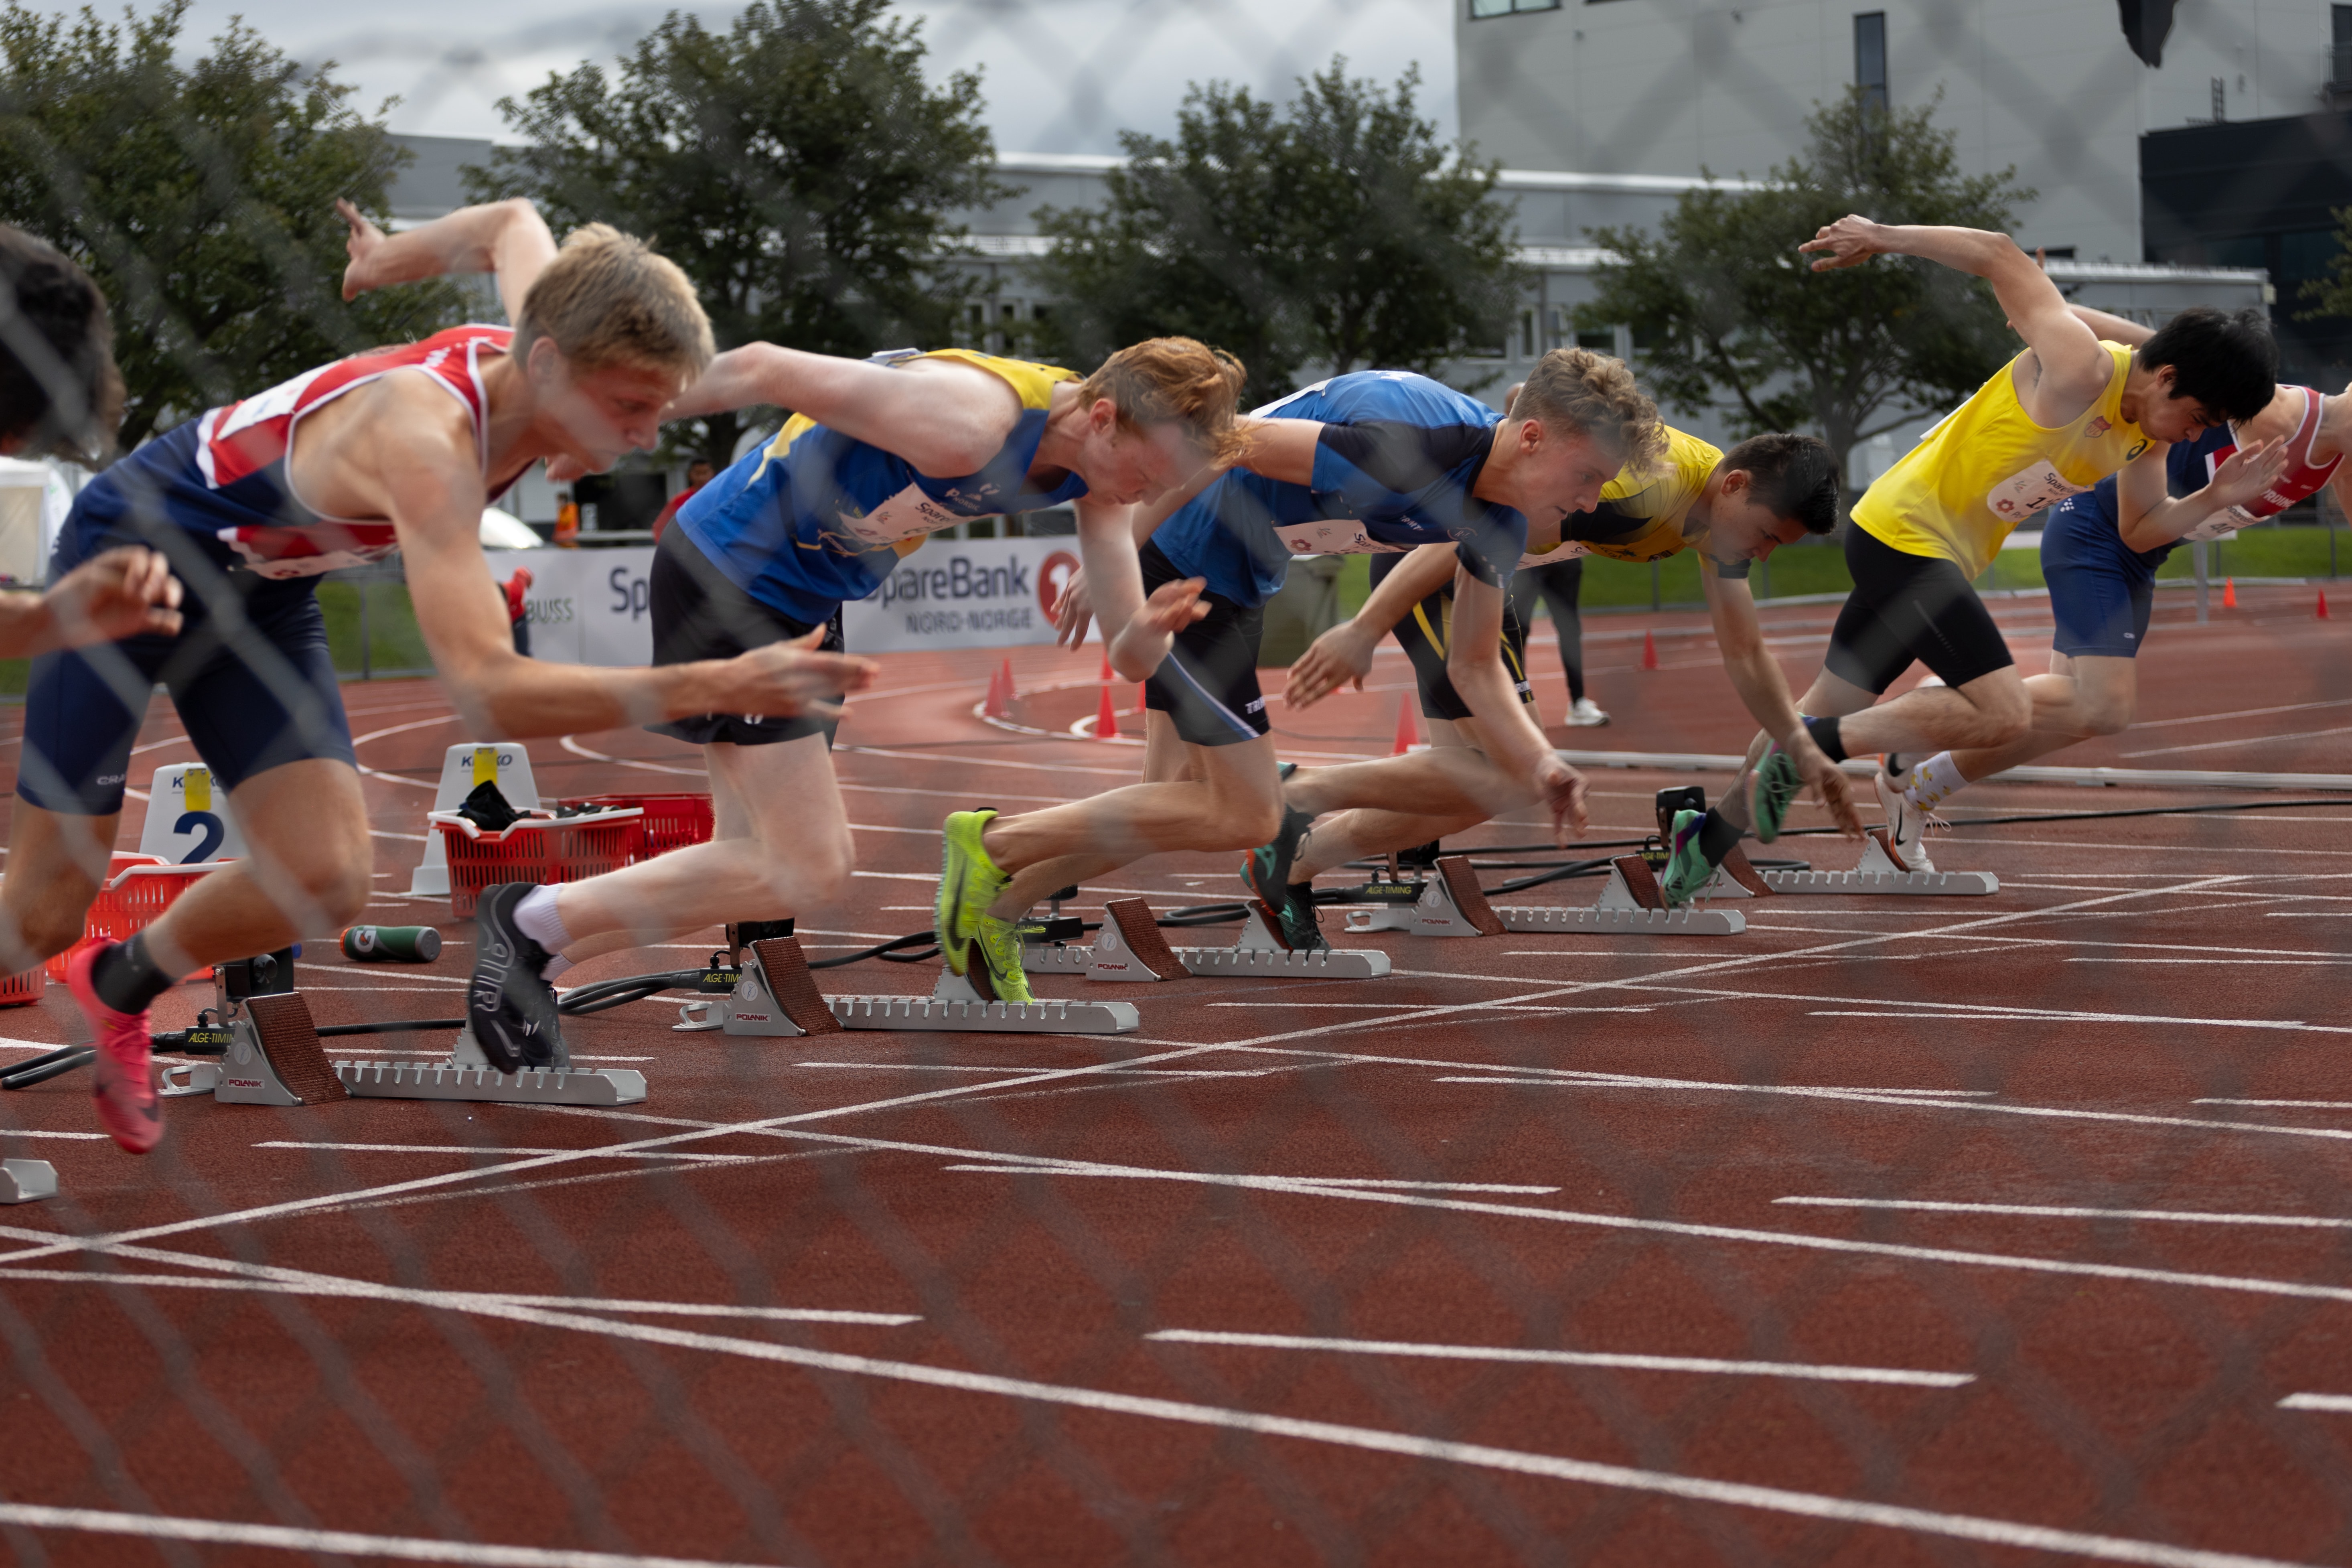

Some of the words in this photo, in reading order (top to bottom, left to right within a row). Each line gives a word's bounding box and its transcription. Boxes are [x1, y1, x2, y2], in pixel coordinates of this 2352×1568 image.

[173, 811, 224, 865] 2
[1365, 886, 1412, 895] ALGE-TIMING
[736, 1014, 768, 1022] POLANIK
[229, 1079, 262, 1088] POLANIK
